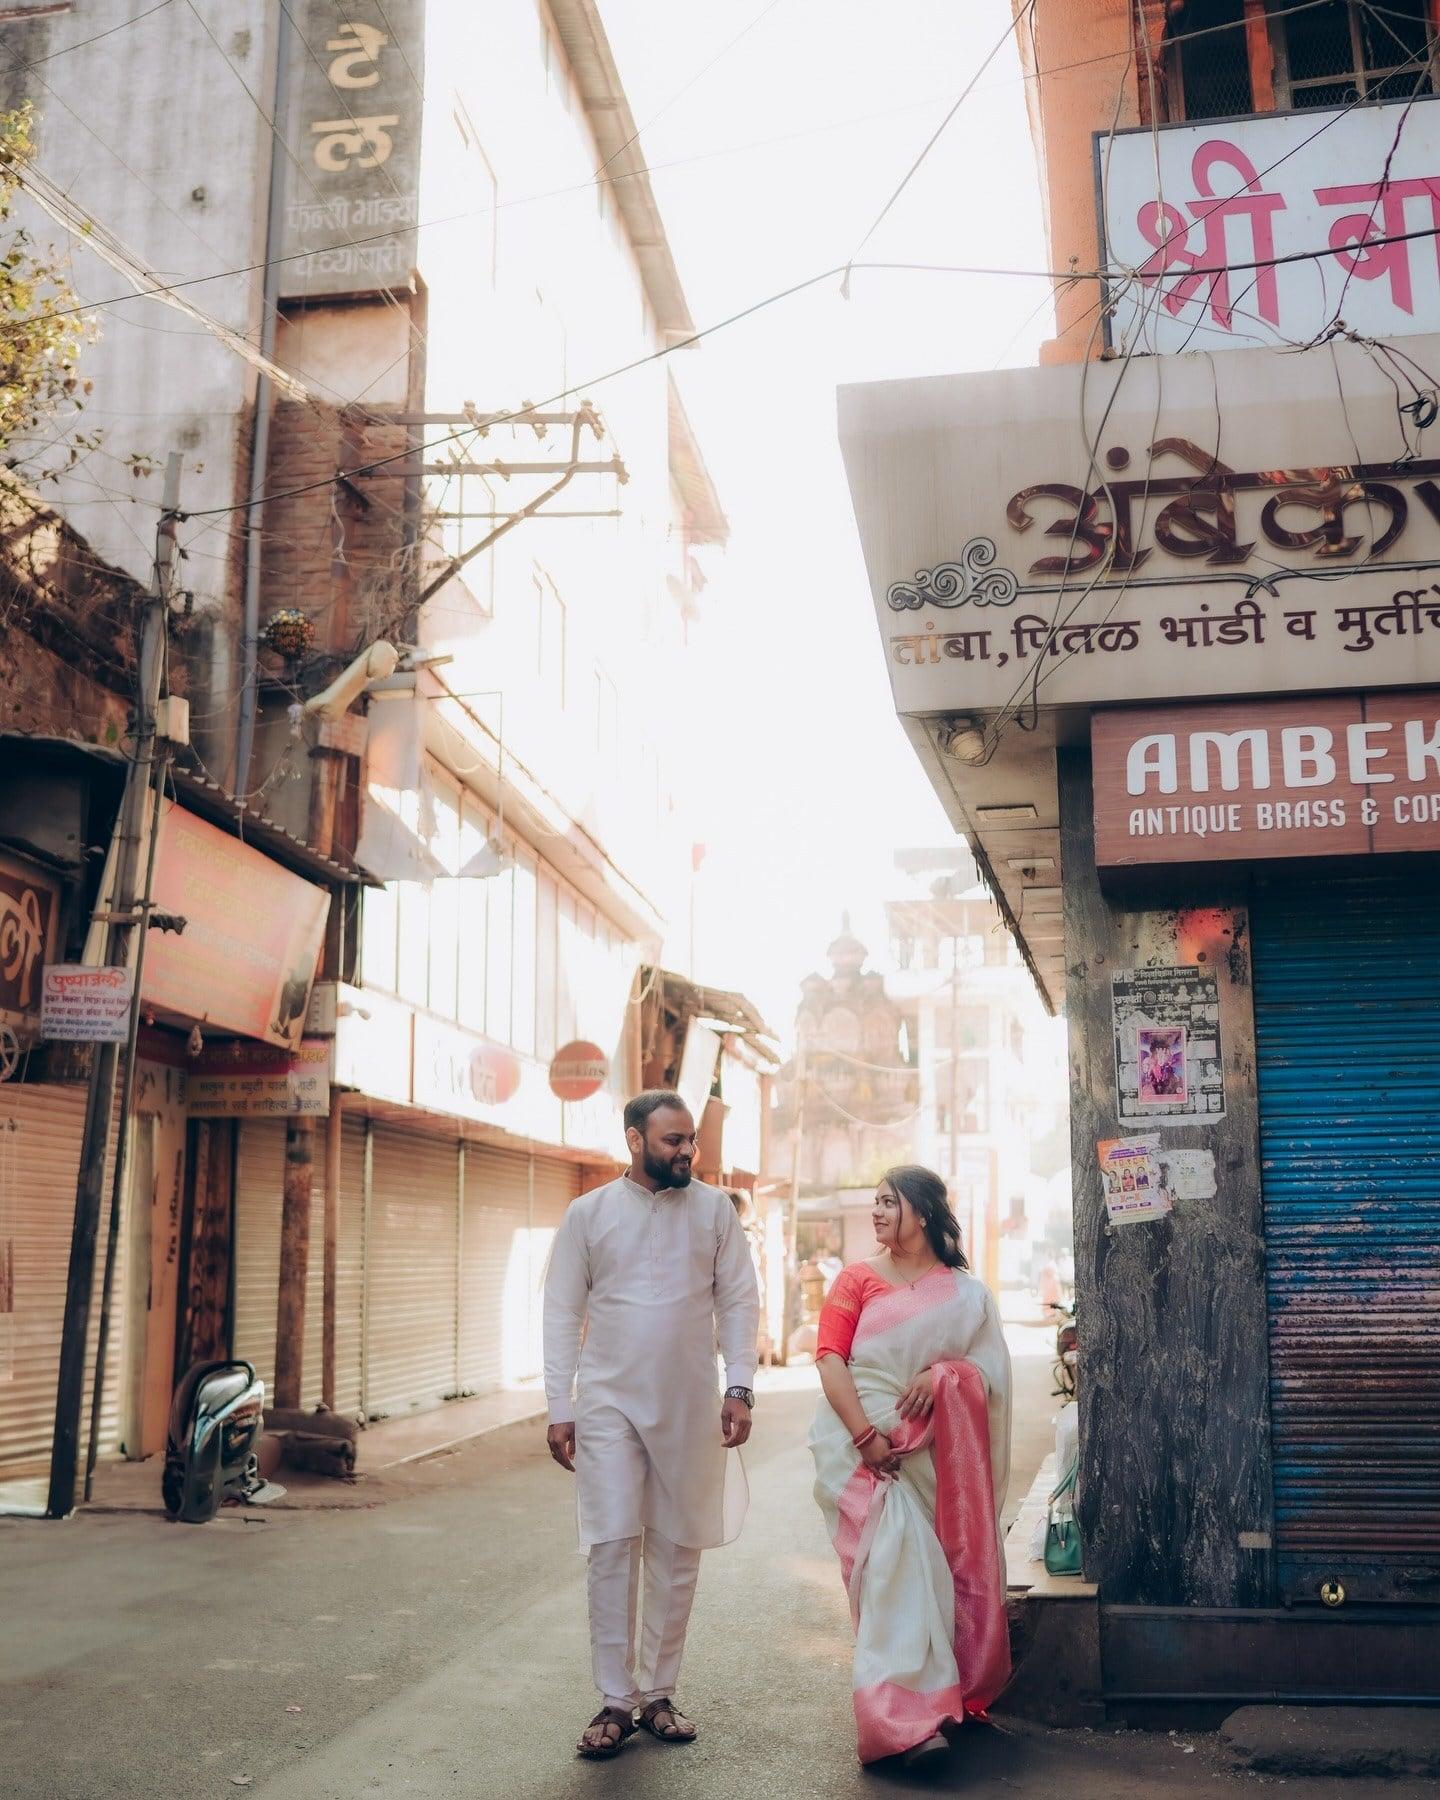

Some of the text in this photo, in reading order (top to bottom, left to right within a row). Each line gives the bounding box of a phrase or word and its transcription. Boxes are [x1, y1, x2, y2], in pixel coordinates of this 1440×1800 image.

[1136, 139, 1287, 333] श्री
[1160, 601, 1266, 649] भांडी
[1284, 610, 1316, 641] व
[1129, 804, 1242, 838] ANTIQUE
[1256, 799, 1346, 831] BRASS
[1361, 797, 1380, 826] &
